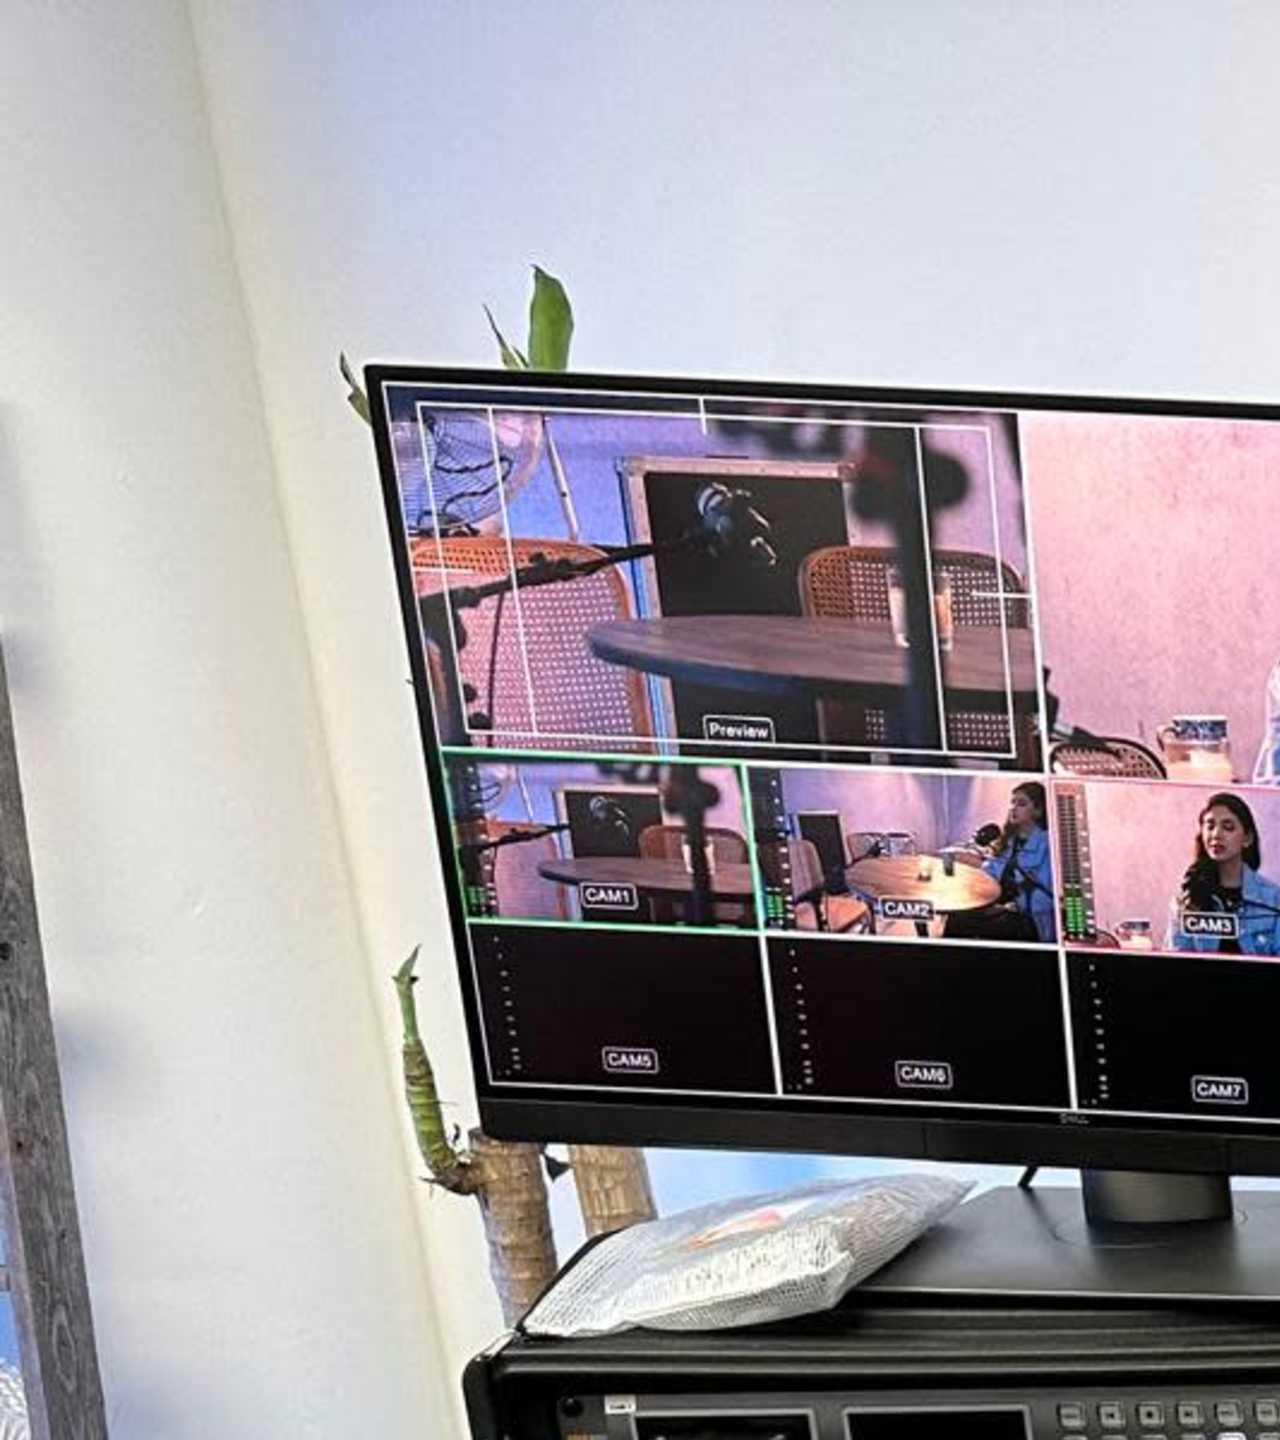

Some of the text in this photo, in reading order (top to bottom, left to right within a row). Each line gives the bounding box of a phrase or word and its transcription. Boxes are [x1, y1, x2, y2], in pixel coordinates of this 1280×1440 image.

[709, 721, 769, 738] Preview
[585, 887, 630, 903] CAM1
[884, 901, 931, 918] CAM2
[1187, 915, 1233, 933] CAM3
[607, 1052, 653, 1069] CAM5
[901, 1066, 947, 1083] CAM6
[1197, 1081, 1242, 1099] CAM7
